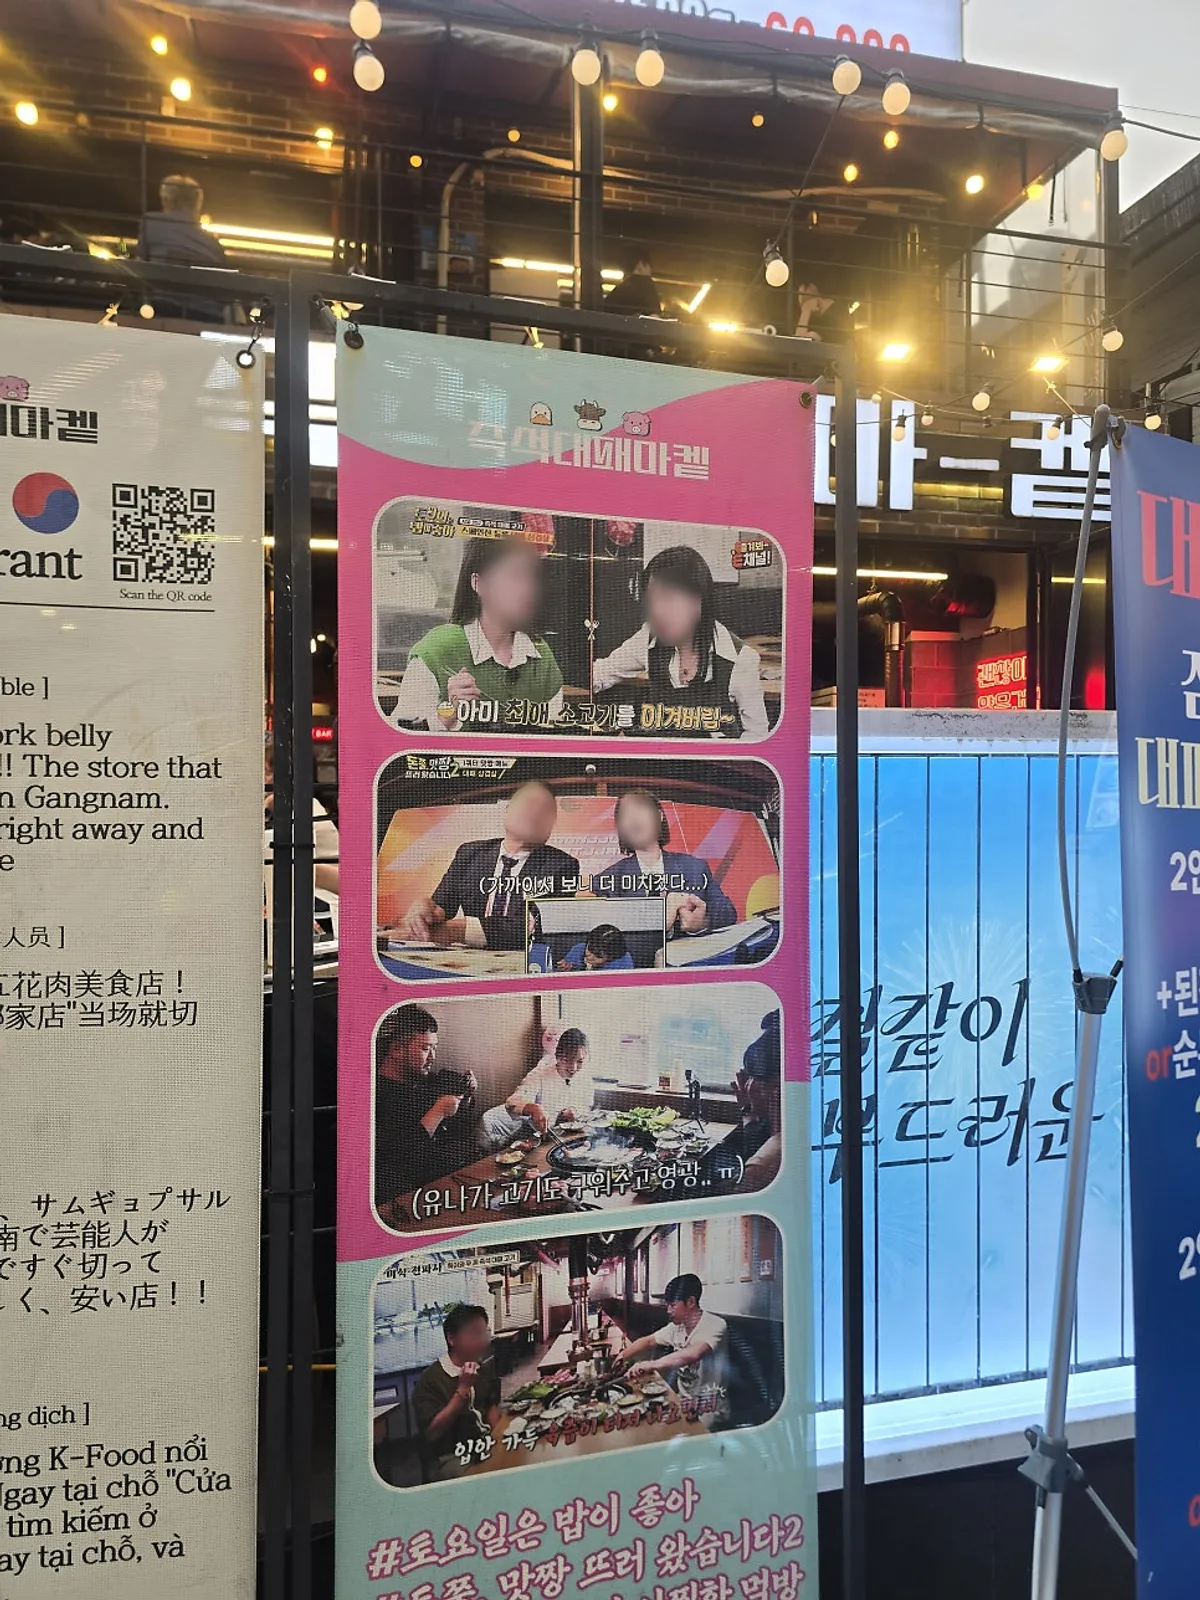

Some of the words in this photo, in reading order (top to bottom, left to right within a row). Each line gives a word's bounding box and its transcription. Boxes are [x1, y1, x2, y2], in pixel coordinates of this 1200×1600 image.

[0, 403, 98, 444] 마켙
[120, 588, 144, 601] Scan
[148, 589, 164, 601] the
[166, 590, 186, 602] QR
[187, 591, 213, 602] code
[557, 700, 636, 729] 소고기를
[0, 722, 37, 746] rk
[46, 722, 113, 752] belly
[23, 754, 79, 778] The
[88, 756, 159, 779] store
[168, 756, 222, 779] that
[25, 785, 169, 814] Gangnam.
[0, 817, 63, 844] right
[72, 822, 145, 844] away
[152, 817, 205, 840] and
[561, 875, 594, 893] 보니
[599, 874, 616, 892] 더
[0, 1000, 198, 1030] 家店"当场就切
[500, 1177, 566, 1207] 고기도
[570, 1166, 652, 1200] 구워주고
[28, 1405, 75, 1429] dịch
[49, 1441, 156, 1471] K-Food
[164, 1434, 208, 1463] nổi
[454, 1435, 496, 1467] 입안
[502, 1427, 540, 1453] 가득
[0, 1482, 56, 1511] gay
[63, 1476, 98, 1506] tại
[106, 1469, 159, 1500] chỗ
[7, 1512, 52, 1538] tìm
[139, 1502, 158, 1529] ở
[367, 1508, 547, 1581] #토요일은
[554, 1491, 621, 1544] 밥이
[629, 1477, 701, 1531] 좋아
[39, 1542, 74, 1573] tại
[82, 1534, 142, 1565] chỗ,
[152, 1533, 185, 1558] và
[576, 1535, 647, 1590] 뜨러
[654, 1513, 805, 1578] 왔습니다2
